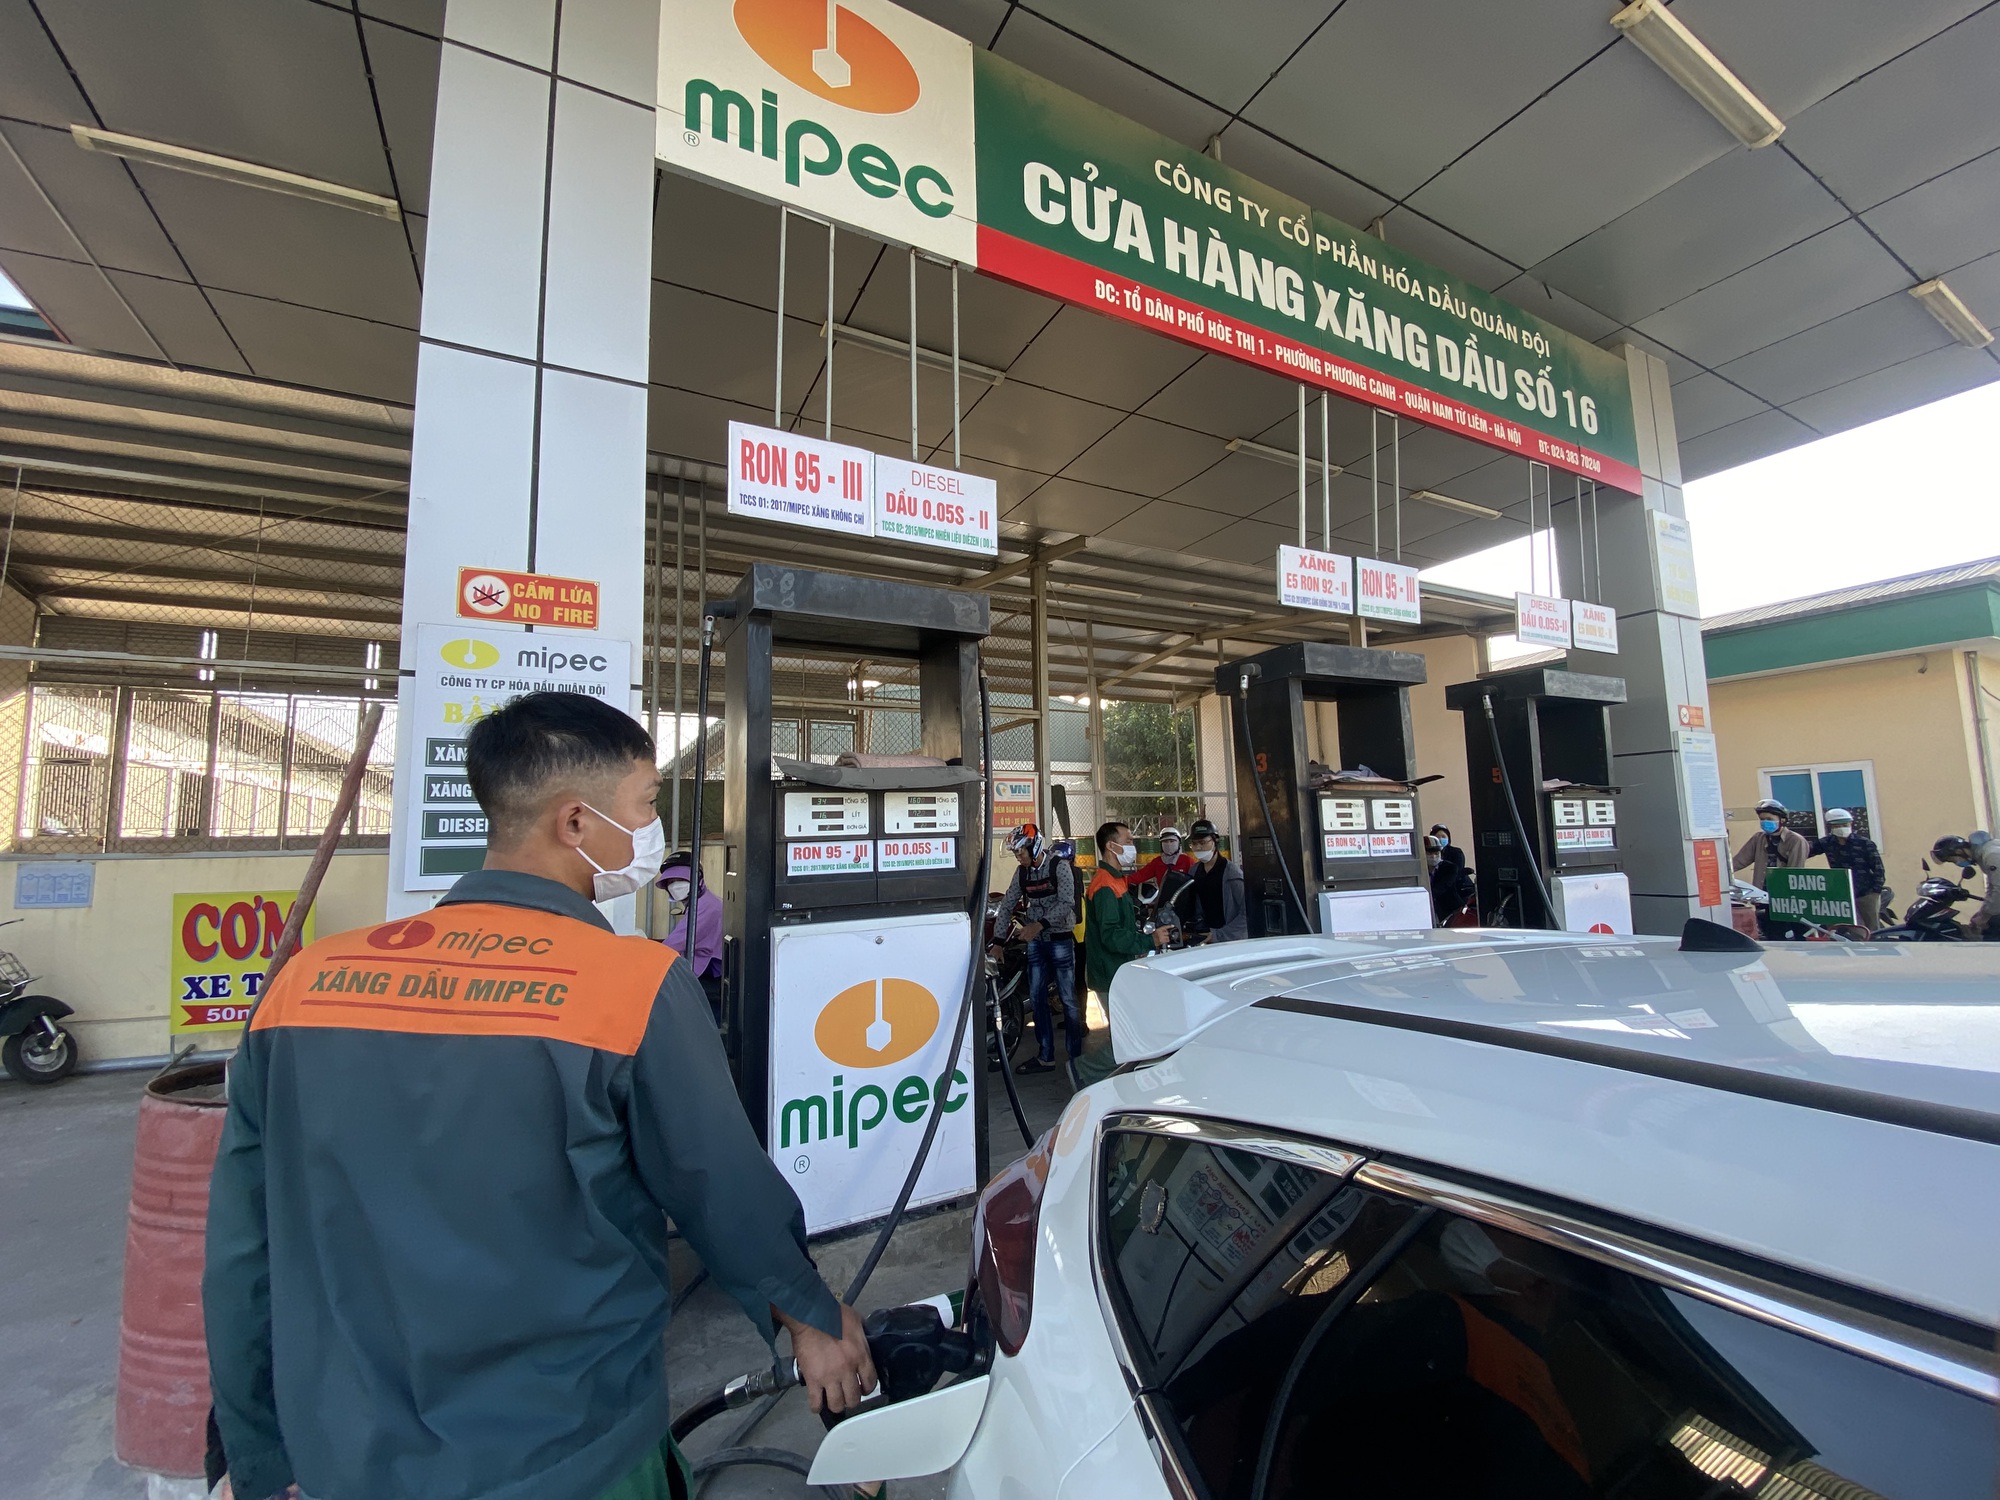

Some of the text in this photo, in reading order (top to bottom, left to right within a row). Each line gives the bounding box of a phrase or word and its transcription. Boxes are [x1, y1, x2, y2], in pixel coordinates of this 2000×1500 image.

[685, 78, 954, 219] mipec
[1154, 159, 1551, 359] CÔNG TY CỔ PHẦN HÓA DẦU QUÂN ĐỘI
[1023, 161, 1155, 265] CỬA
[1163, 216, 1306, 323] HÀNG
[1312, 280, 1431, 373] XĂNG
[1436, 332, 1509, 402] DẦU
[1513, 365, 1558, 420] SỐ
[1094, 279, 1522, 447] ĐC: TỔ DÂN PHỐ HÒE THỊ 1 PHƯỜNG PHƯƠNG CANH QUẬN NAM TỪ LIÊM HÀ NỘI
[740, 438, 788, 489] RON
[794, 450, 821, 495] 95
[1550, 443, 1565, 462] 024
[1566, 447, 1579, 466] 383
[1580, 453, 1602, 474] 70240
[911, 470, 965, 496] DIESEL
[739, 493, 758, 507] TCCS
[758, 496, 769, 509] 01:
[770, 498, 811, 517] 2017/MIPEC
[811, 504, 830, 520] XĂNG
[831, 507, 853, 524] KHÔNG
[885, 489, 918, 517] DẦU
[922, 499, 965, 526] 0.05S
[881, 520, 895, 533] TCCS
[1298, 553, 1336, 574] XĂNG
[513, 579, 555, 601] CẤM
[1286, 572, 1298, 589] E5
[1300, 575, 1320, 593] RON
[1322, 578, 1333, 595] 92
[1361, 568, 1383, 598] RON
[1385, 571, 1397, 601] 95
[513, 602, 594, 625] NO FIRE
[1530, 599, 1558, 613] DIESEL
[1583, 607, 1606, 623] XĂNG
[517, 646, 608, 674] mipec
[440, 675, 472, 689] CÔNG
[475, 678, 488, 689] TY
[491, 679, 506, 690] CP
[508, 680, 531, 692] HÓA
[588, 684, 606, 697] ĐỘI
[1255, 752, 1268, 773] 3
[1492, 767, 1503, 783] 5
[430, 780, 473, 798] XĂNG
[793, 846, 822, 861] RON
[825, 845, 842, 860] 95
[884, 843, 899, 857] DO
[902, 841, 932, 856] 0.05S
[1326, 837, 1334, 848] E5
[1335, 837, 1348, 847] RON
[1372, 837, 1386, 847] RON
[1386, 836, 1395, 846] 95
[1788, 874, 1826, 891] ĐANG
[1771, 895, 1852, 918] NHẬP HÀNG
[182, 894, 303, 963] CƠM
[437, 927, 554, 959] mipec
[182, 973, 232, 1001] XE
[308, 965, 569, 1007] XĂNG DẦU MIPEC
[780, 1068, 969, 1150] mipec
